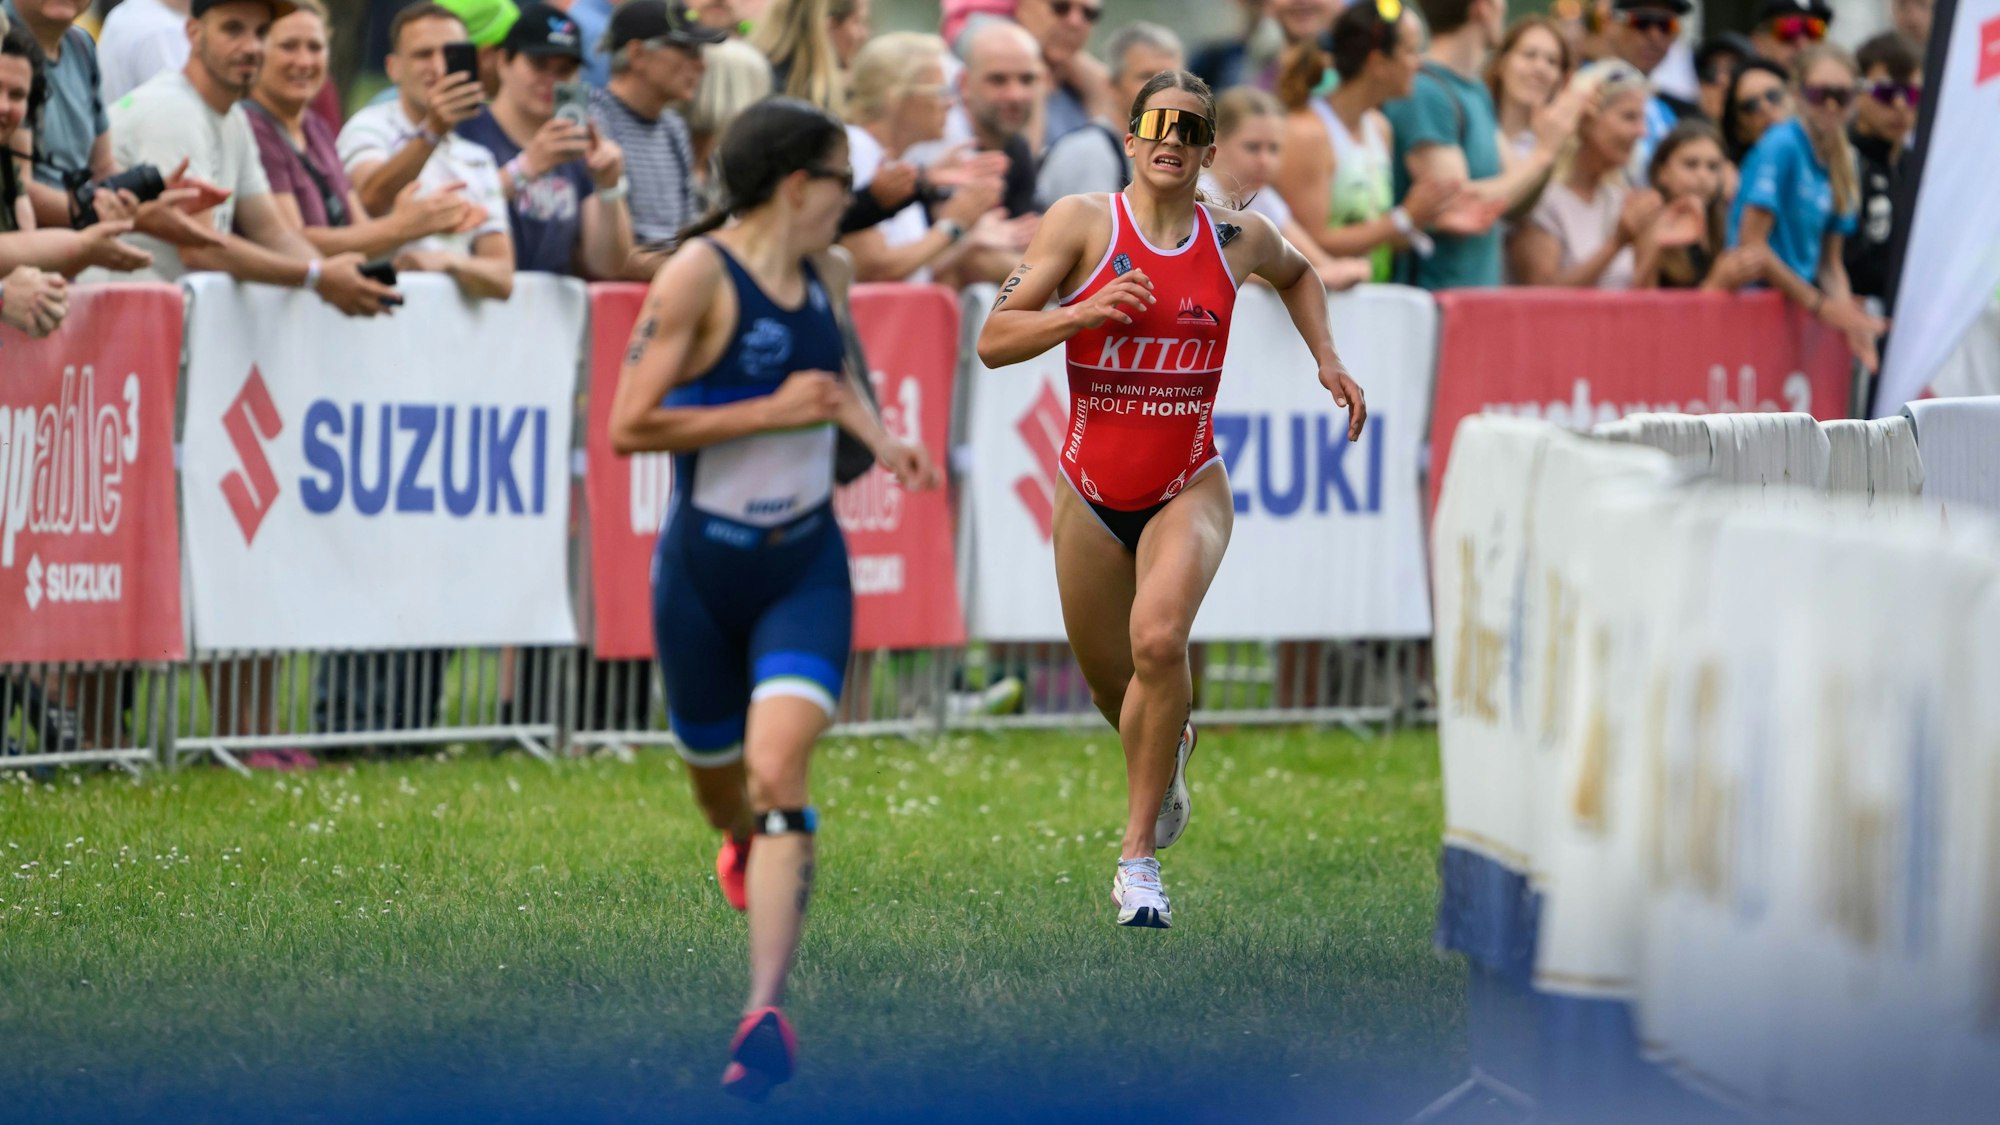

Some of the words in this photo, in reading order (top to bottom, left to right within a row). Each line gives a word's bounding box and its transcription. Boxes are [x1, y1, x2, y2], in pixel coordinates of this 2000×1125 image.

[1089, 396, 1137, 415] ROLF
[1141, 400, 1201, 416] HORN
[1091, 382, 1112, 394] IHR
[1116, 385, 1145, 396] MINI
[1149, 386, 1203, 398] PARTNER
[299, 398, 548, 517] SUZUKI
[1213, 413, 1384, 517] ZUKI
[46, 562, 122, 603] SUZUKI
